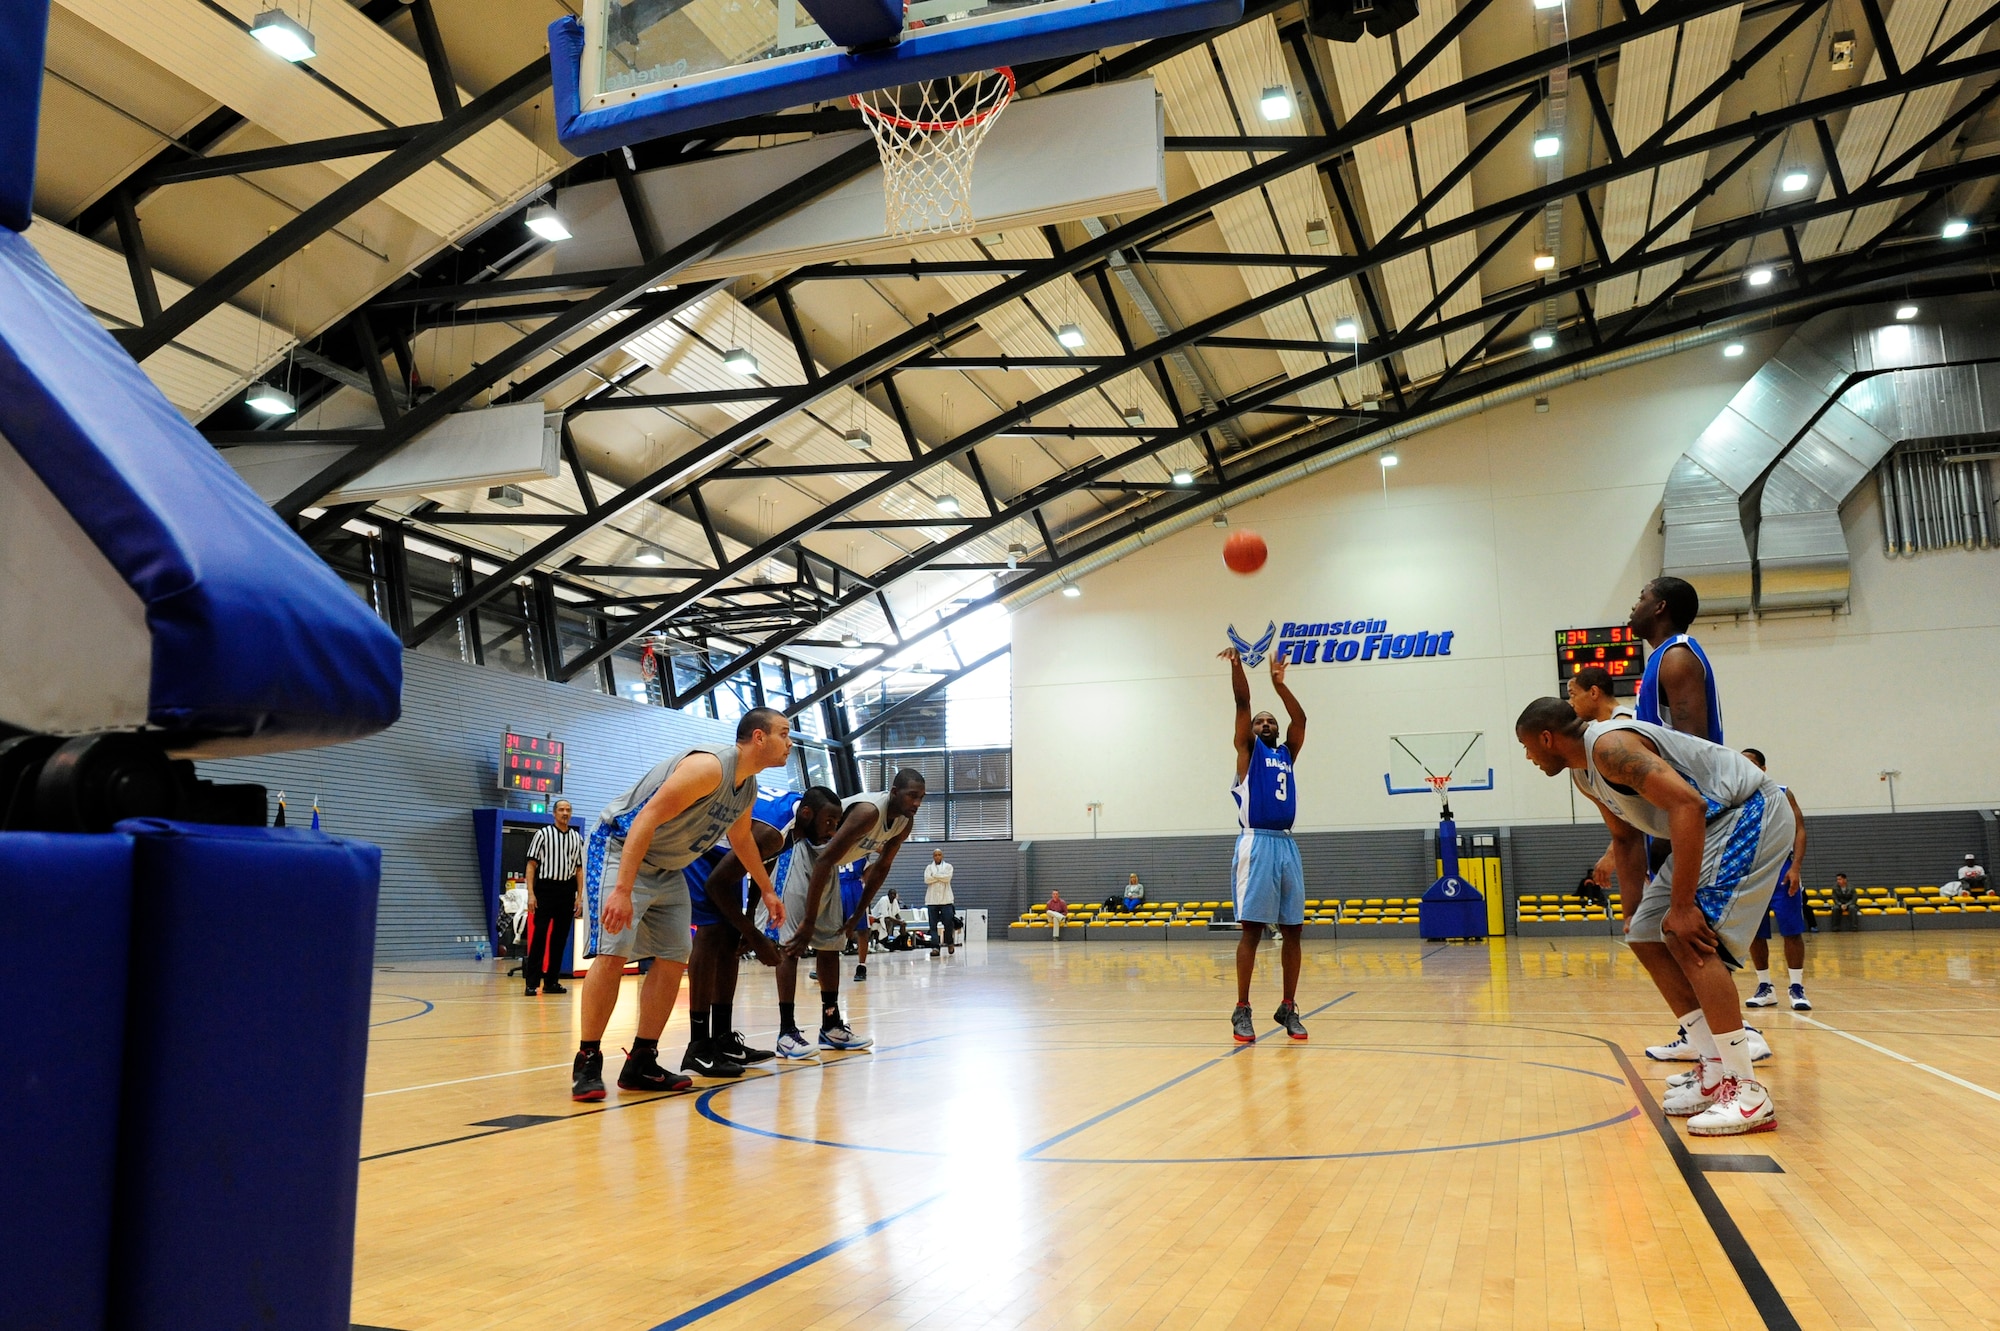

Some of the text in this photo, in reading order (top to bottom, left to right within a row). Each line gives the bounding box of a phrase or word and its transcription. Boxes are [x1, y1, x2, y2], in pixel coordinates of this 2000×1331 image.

[1279, 618, 1387, 638] Ramstein
[1557, 632, 1566, 644] H
[1567, 630, 1587, 644] 34
[1611, 627, 1632, 642] 51
[1277, 630, 1454, 665] Fit to Fight
[1595, 647, 1605, 659] 2
[506, 734, 519, 748] 34
[531, 738, 538, 750] 2
[549, 742, 562, 754] 51
[554, 761, 560, 774] 2
[1275, 772, 1287, 801] 3
